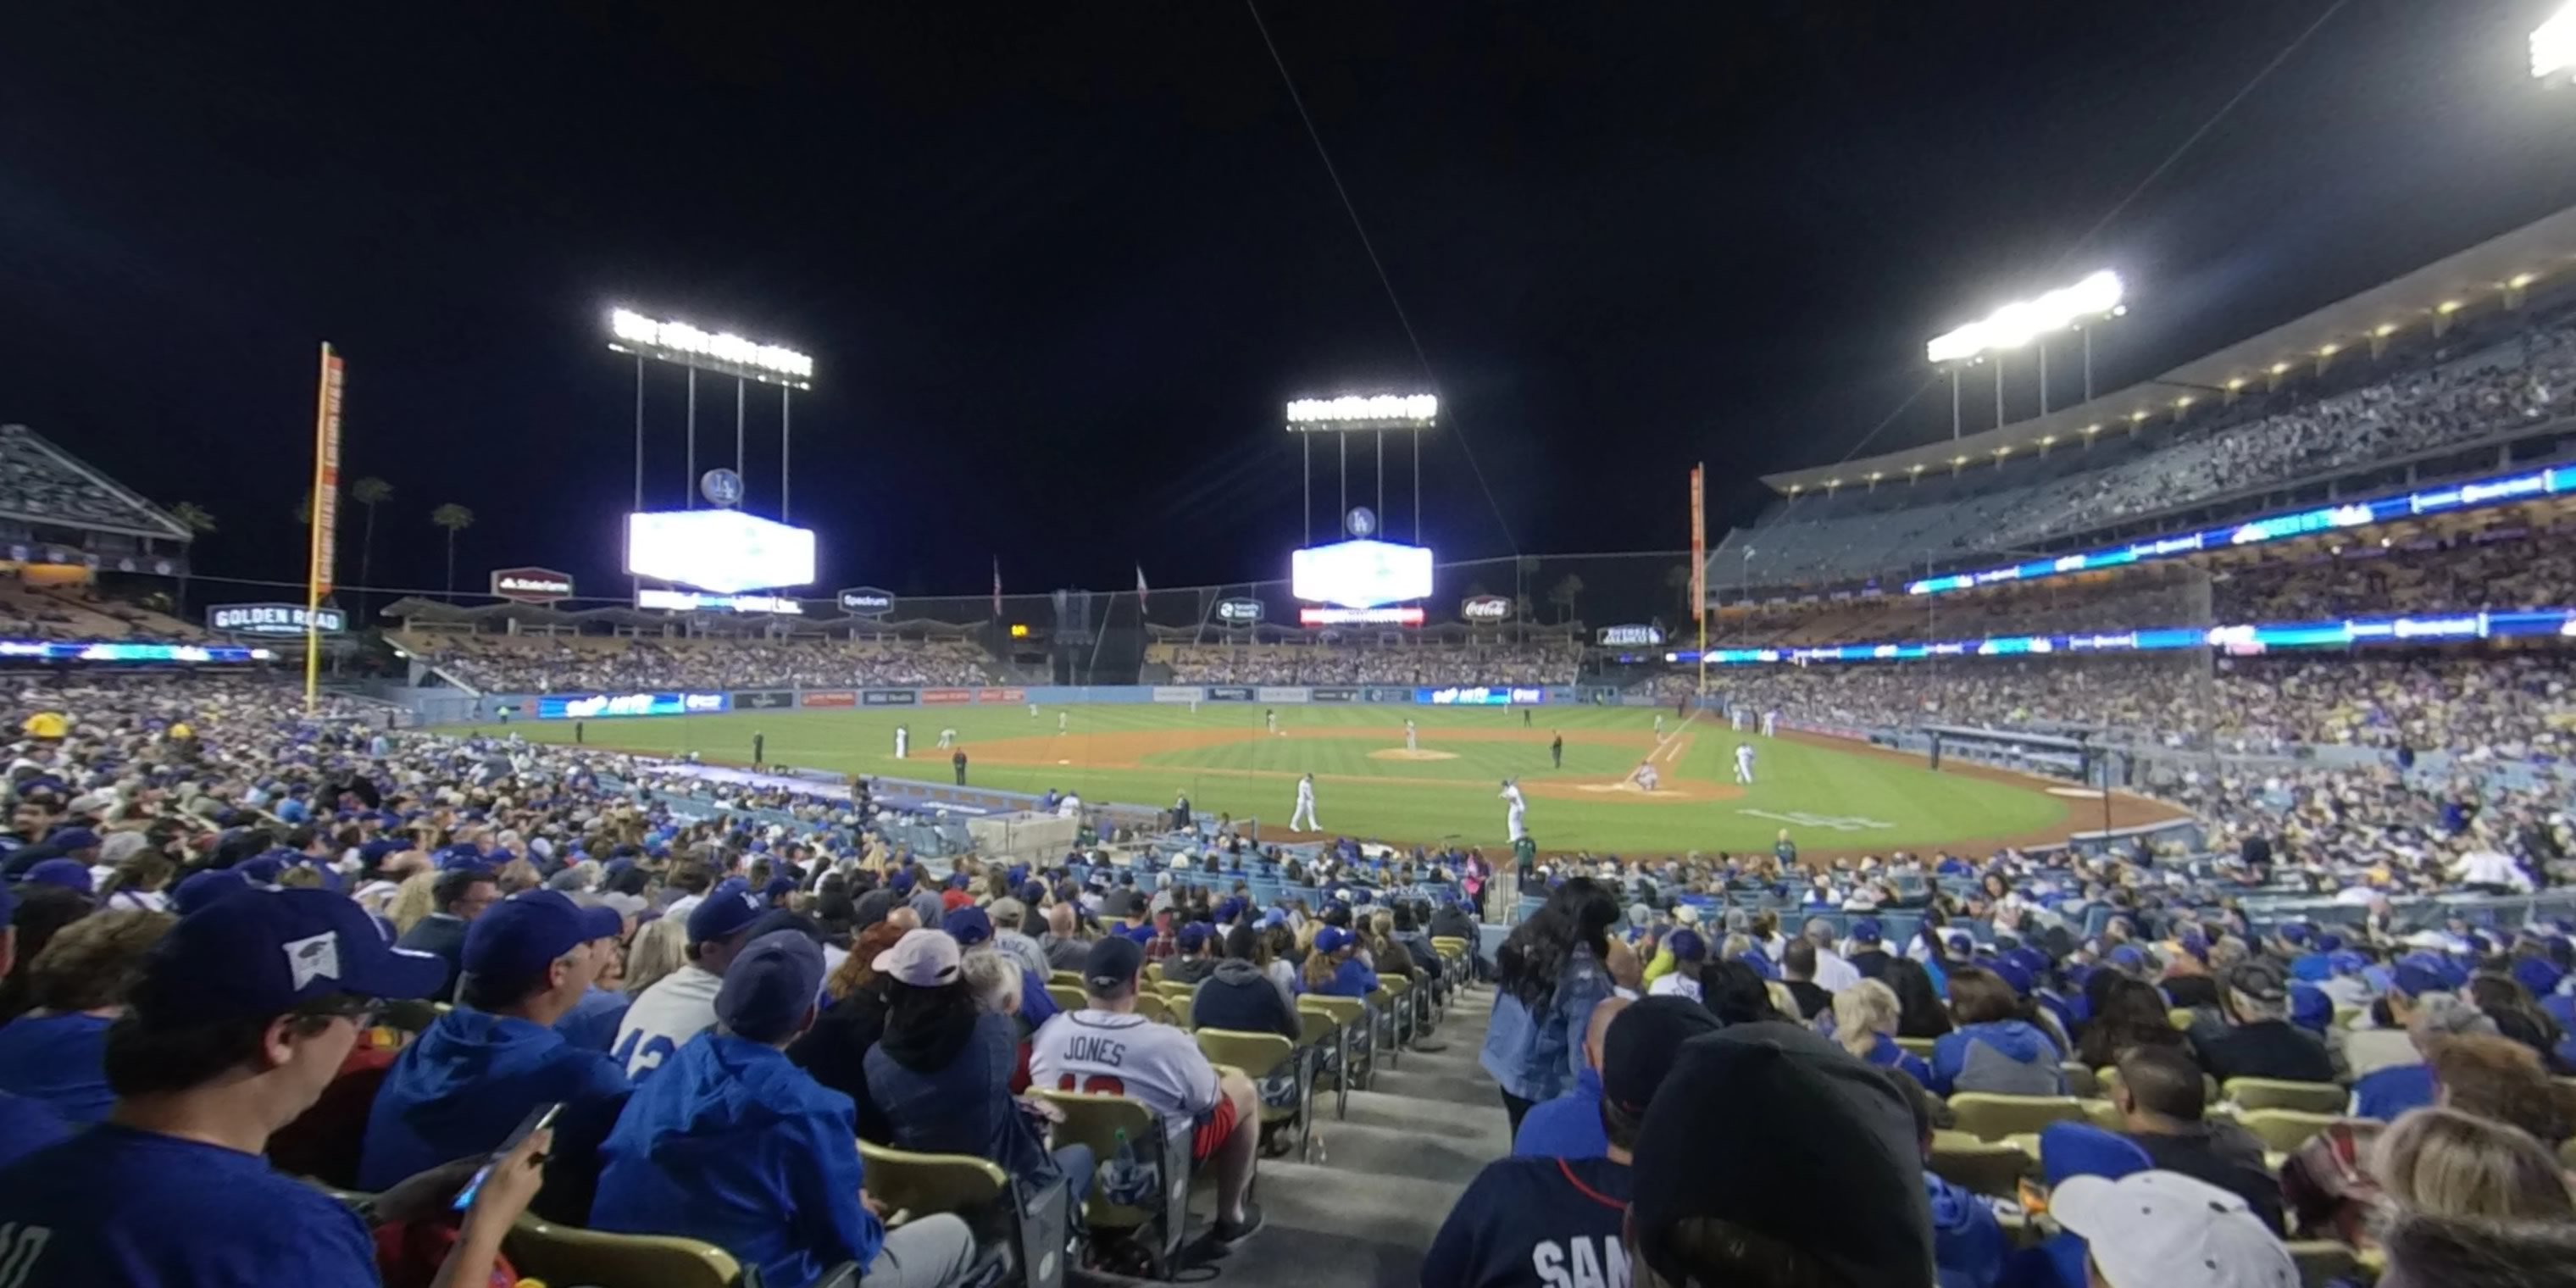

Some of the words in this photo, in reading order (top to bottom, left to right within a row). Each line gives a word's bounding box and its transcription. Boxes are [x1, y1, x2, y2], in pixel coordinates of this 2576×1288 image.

[215, 608, 287, 627] GOLDEN
[293, 608, 339, 630] ROAD
[1063, 1035, 1126, 1067] JONES
